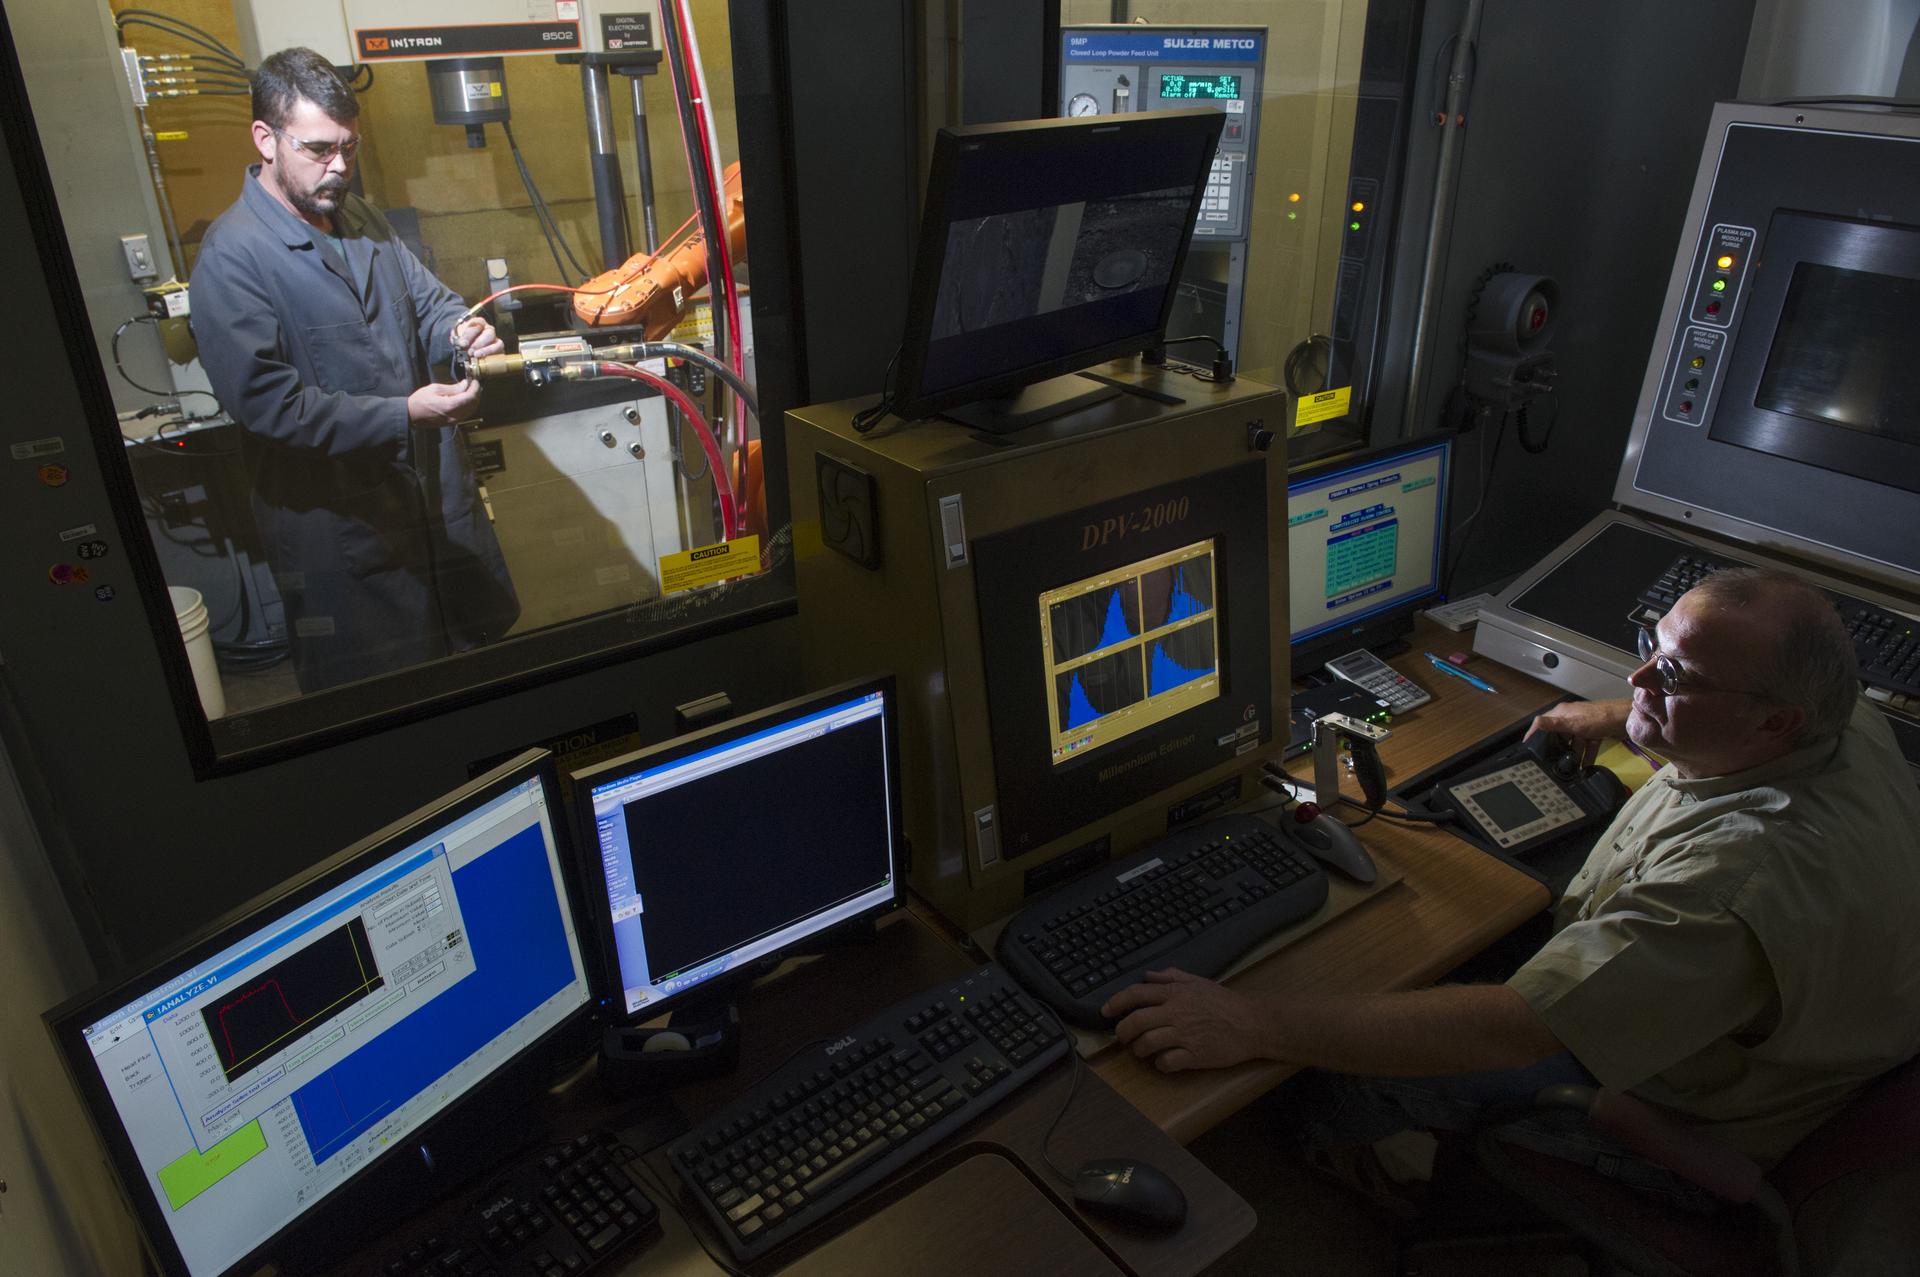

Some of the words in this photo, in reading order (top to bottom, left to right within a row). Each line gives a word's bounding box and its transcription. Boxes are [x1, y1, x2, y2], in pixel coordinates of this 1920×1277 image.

[390, 36, 443, 49] INSTRON
[542, 31, 574, 41] 8502
[1070, 38, 1088, 46] 9MP
[1163, 38, 1209, 49] SULZER
[1213, 39, 1255, 49] METCO
[1717, 227, 1739, 237] PLASMA
[1739, 230, 1752, 238] GAS
[1721, 234, 1744, 243] MODULE
[1722, 241, 1741, 249] PURGE
[1693, 336, 1715, 345] MODULE
[1693, 343, 1713, 351] PURGE
[1080, 495, 1190, 551] DPV-2000
[693, 546, 728, 560] CAUTION
[1097, 749, 1157, 783] Millennium
[1159, 733, 1195, 756] Edition
[597, 782, 616, 792] Windows
[616, 778, 629, 786] Media
[629, 773, 642, 782] Player
[418, 970, 436, 985] Return
[127, 998, 146, 1013] (no
[179, 1022, 200, 1037] 1000.0
[190, 1043, 209, 1057] 600.0
[824, 1034, 857, 1056] DELL
[195, 1054, 213, 1067] 400.0
[199, 1064, 217, 1078] 200.0
[129, 1073, 153, 1091] Trigger
[205, 1103, 231, 1124] Analyze
[232, 1084, 261, 1105] Selected
[260, 1069, 282, 1087] Subset
[1121, 1165, 1135, 1184] DELL
[481, 1196, 514, 1219] DELL
